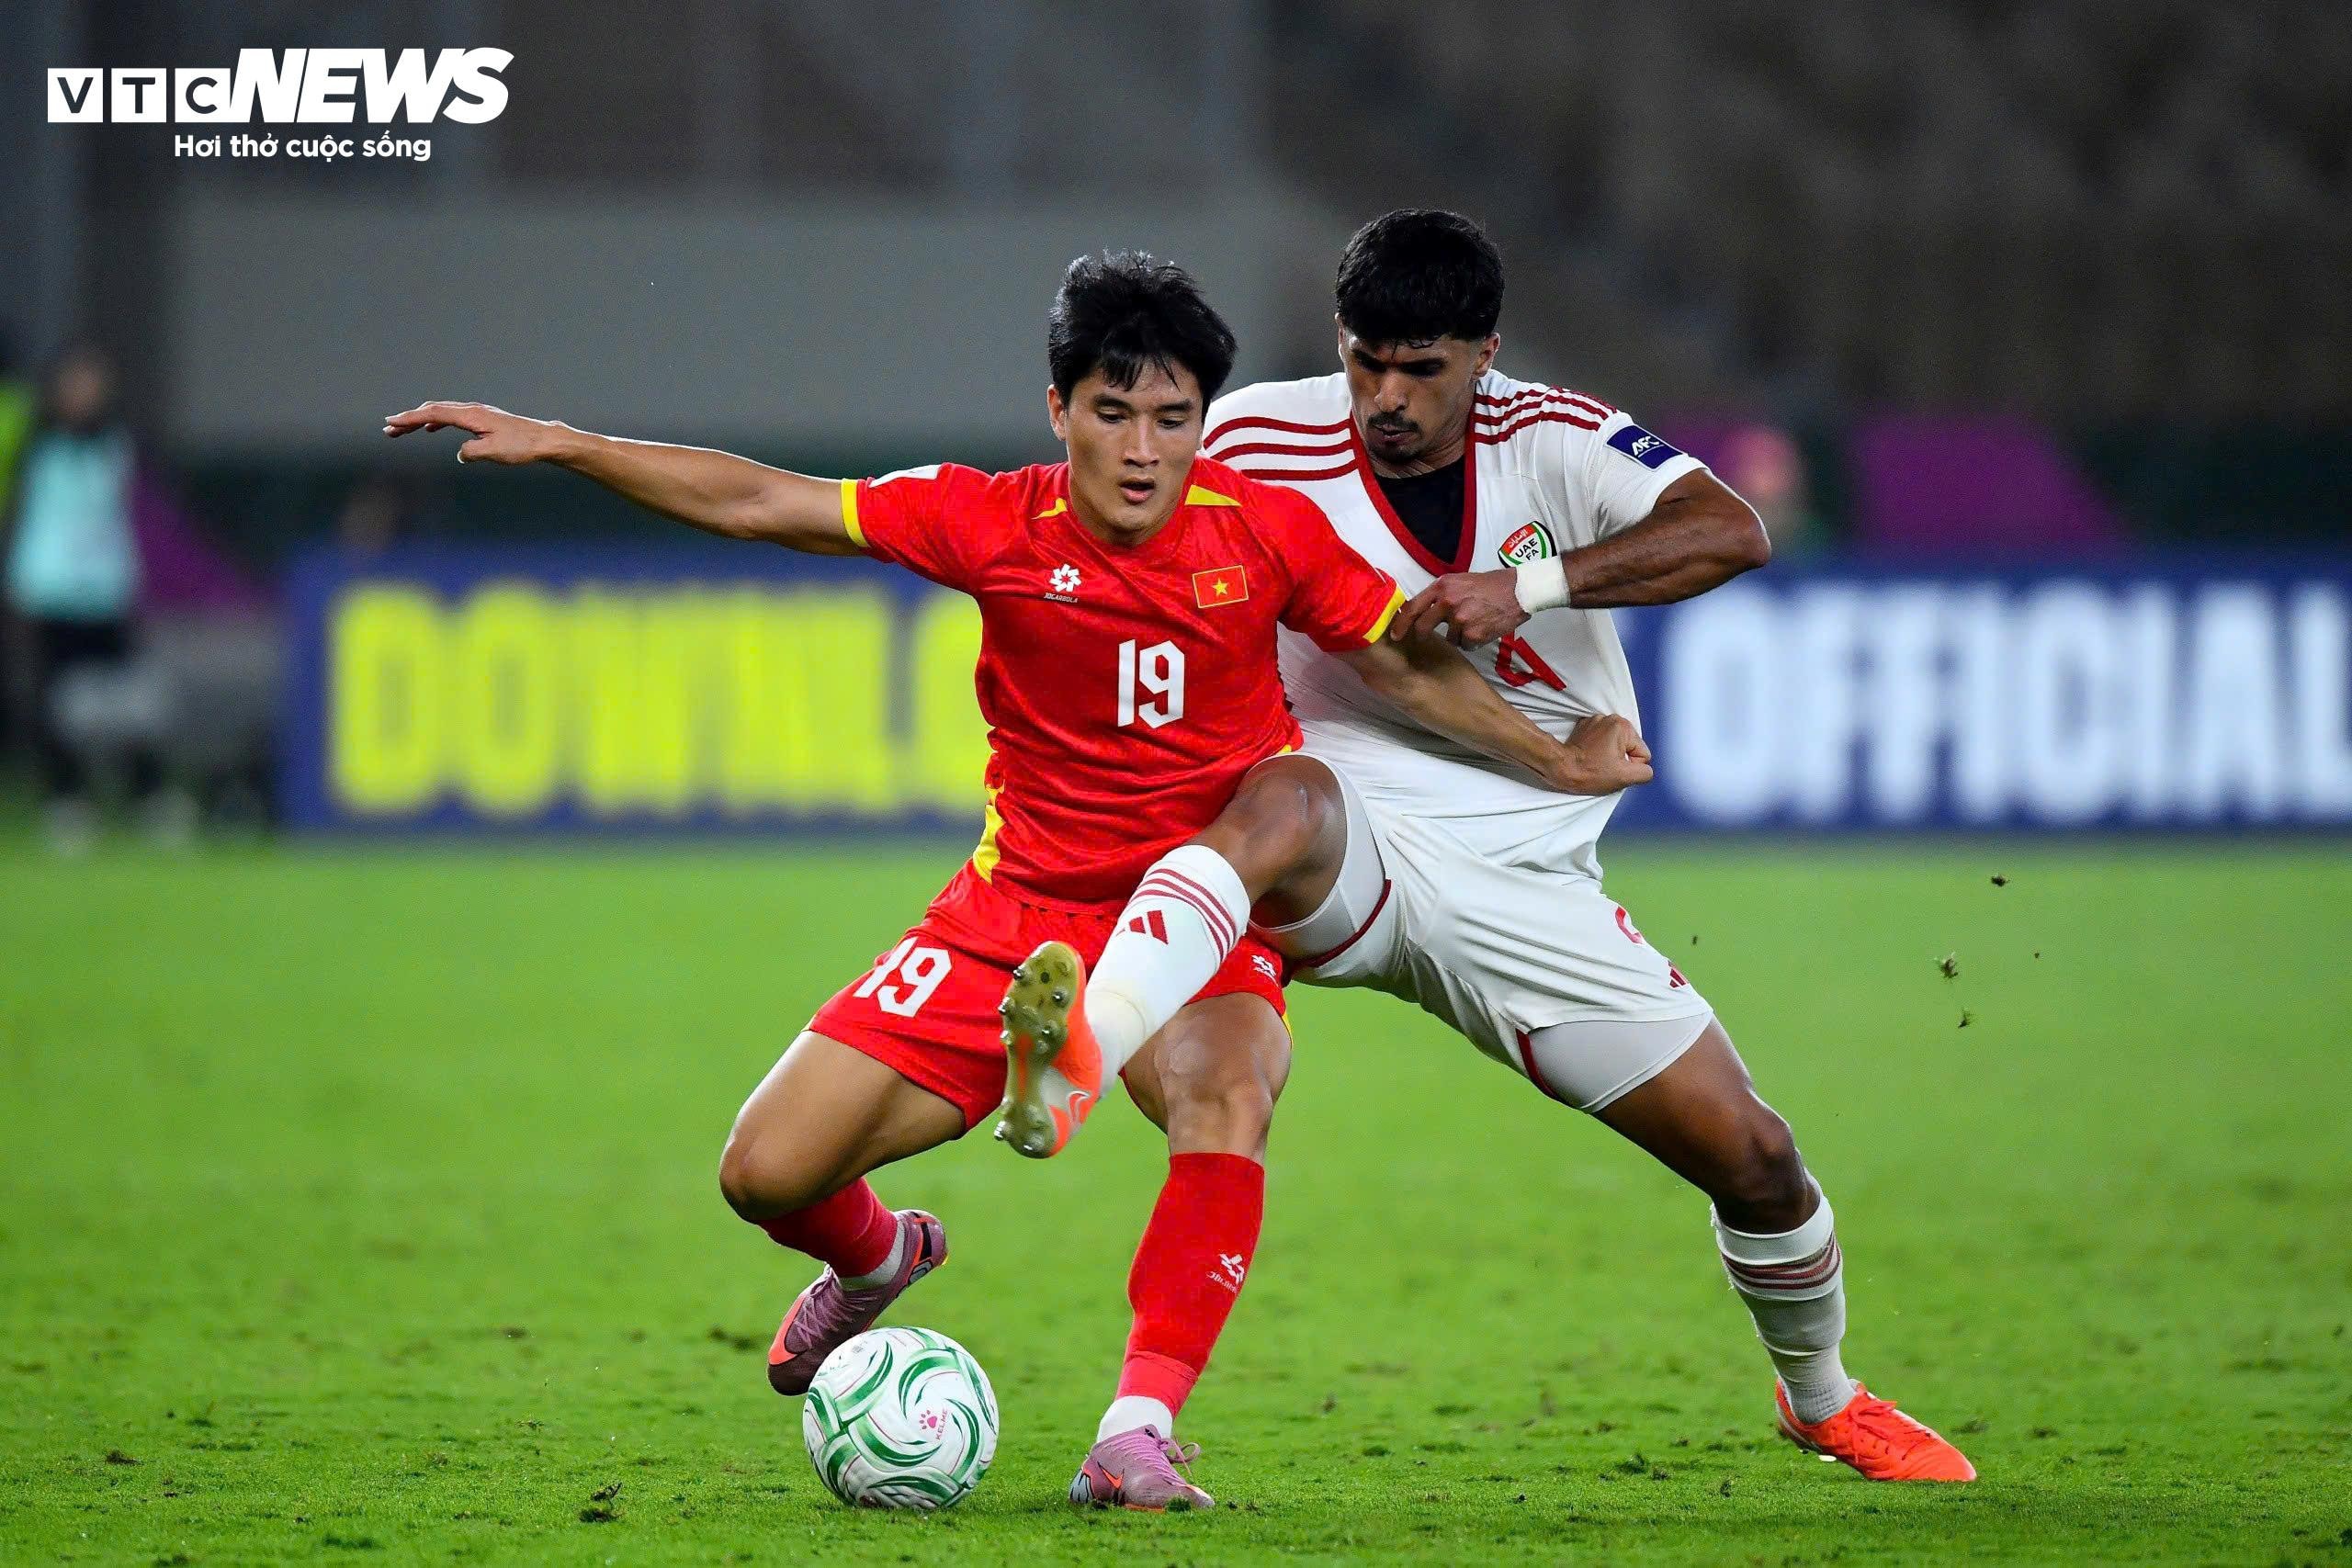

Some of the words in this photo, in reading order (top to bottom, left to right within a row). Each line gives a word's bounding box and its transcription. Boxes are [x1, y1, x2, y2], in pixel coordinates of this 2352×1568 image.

[1632, 435, 1660, 457] AFC
[1515, 538, 1538, 558] UAE
[1525, 549, 1539, 560] FA
[1117, 638, 1185, 728] 19
[1668, 582, 2352, 818] OFFICIAL
[853, 936, 953, 1018] 19
[935, 1408, 948, 1440] KELME
